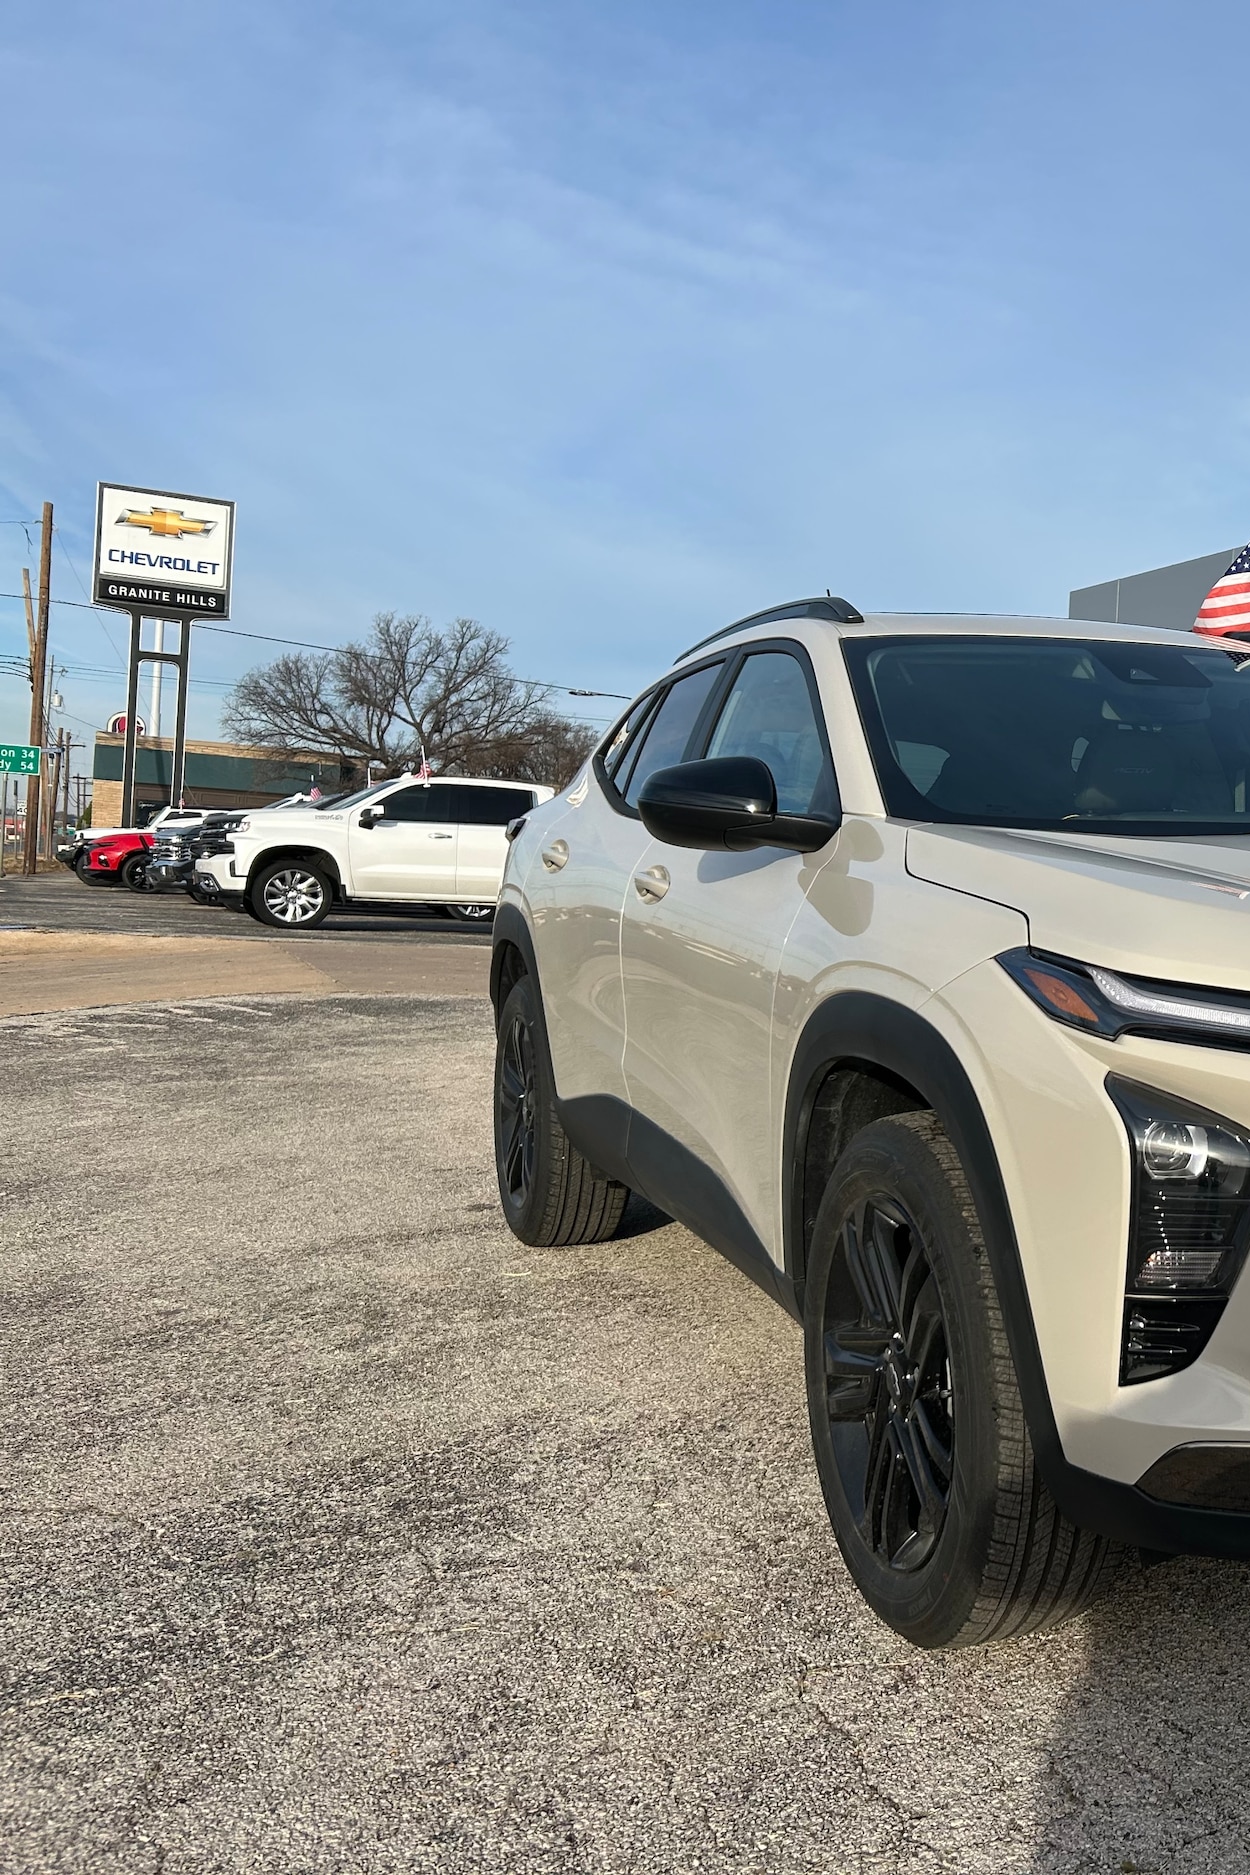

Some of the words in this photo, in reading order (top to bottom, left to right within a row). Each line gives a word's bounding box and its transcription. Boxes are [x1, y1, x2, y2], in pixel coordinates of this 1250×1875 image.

[108, 548, 220, 575] CHEVROLET
[108, 584, 171, 602] GRANITE
[176, 592, 217, 608] HILLS
[21, 749, 35, 759] 34
[20, 761, 34, 771] 54
